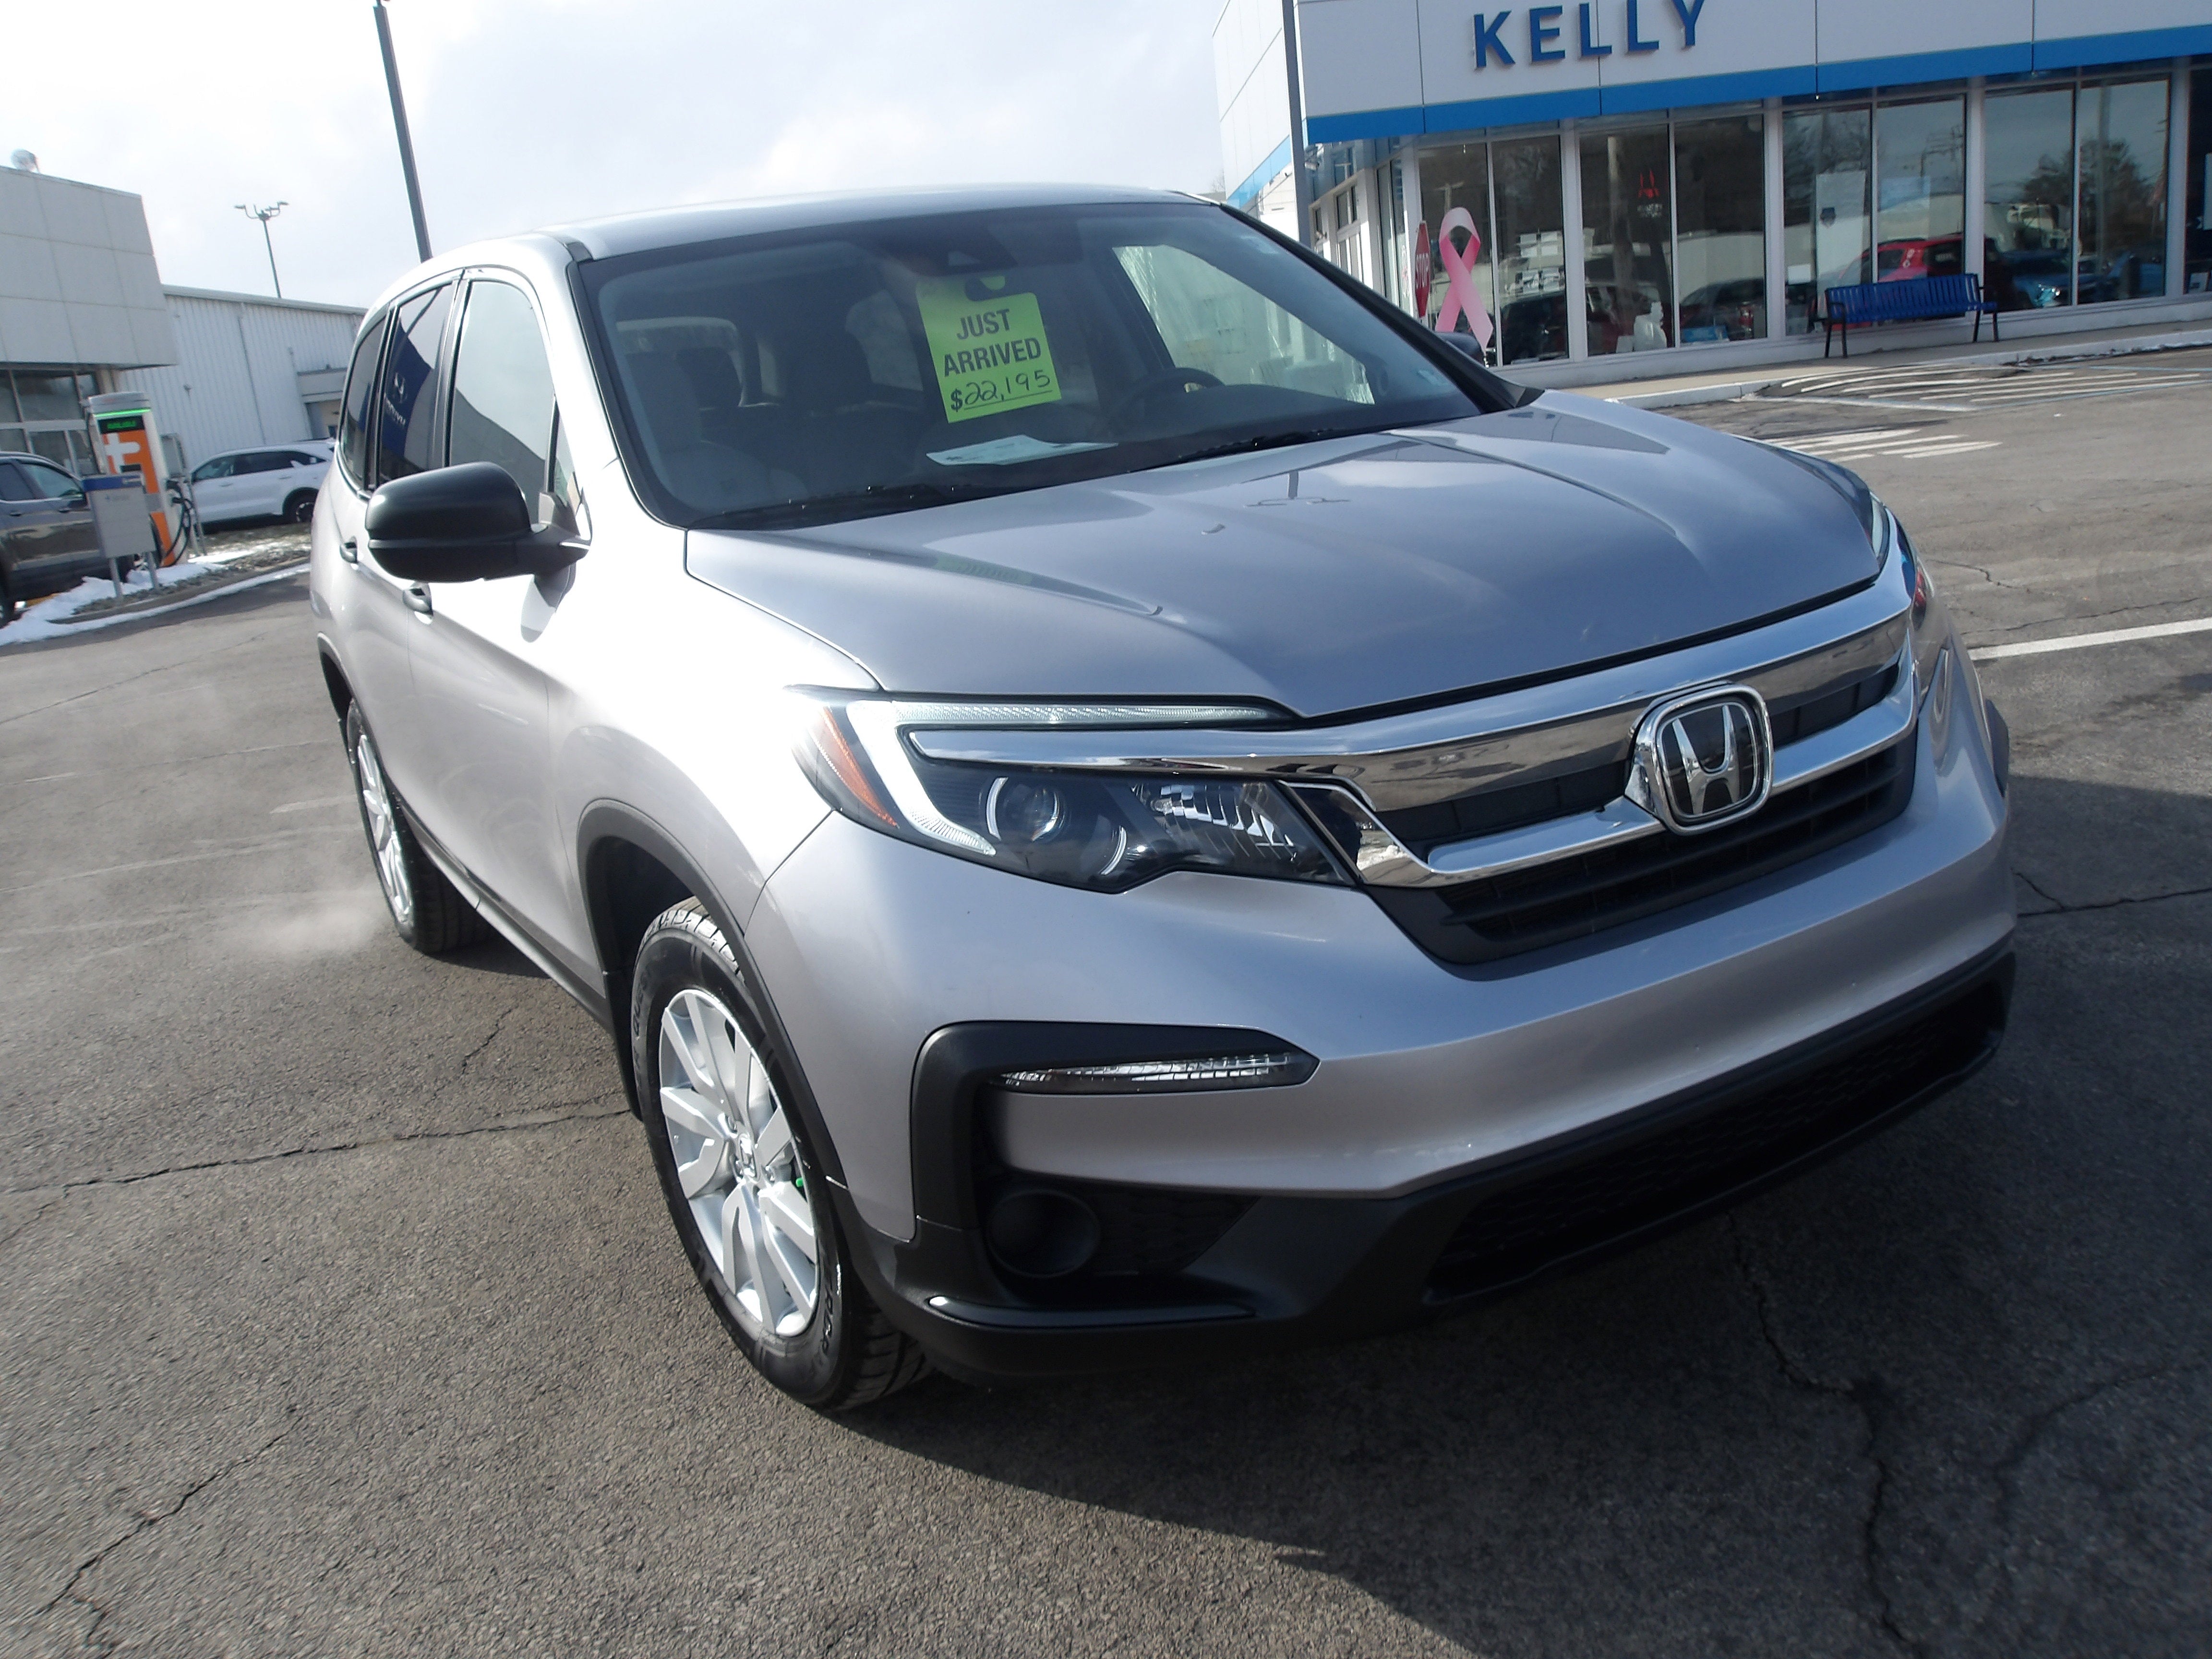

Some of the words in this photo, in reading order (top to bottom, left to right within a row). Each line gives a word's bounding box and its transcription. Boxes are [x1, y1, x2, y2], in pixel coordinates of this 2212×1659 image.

[1473, 0, 1704, 68] KELLY
[1416, 252, 1429, 289] STOP
[956, 309, 1010, 340] JUST
[944, 337, 1042, 377] ARRIVED
